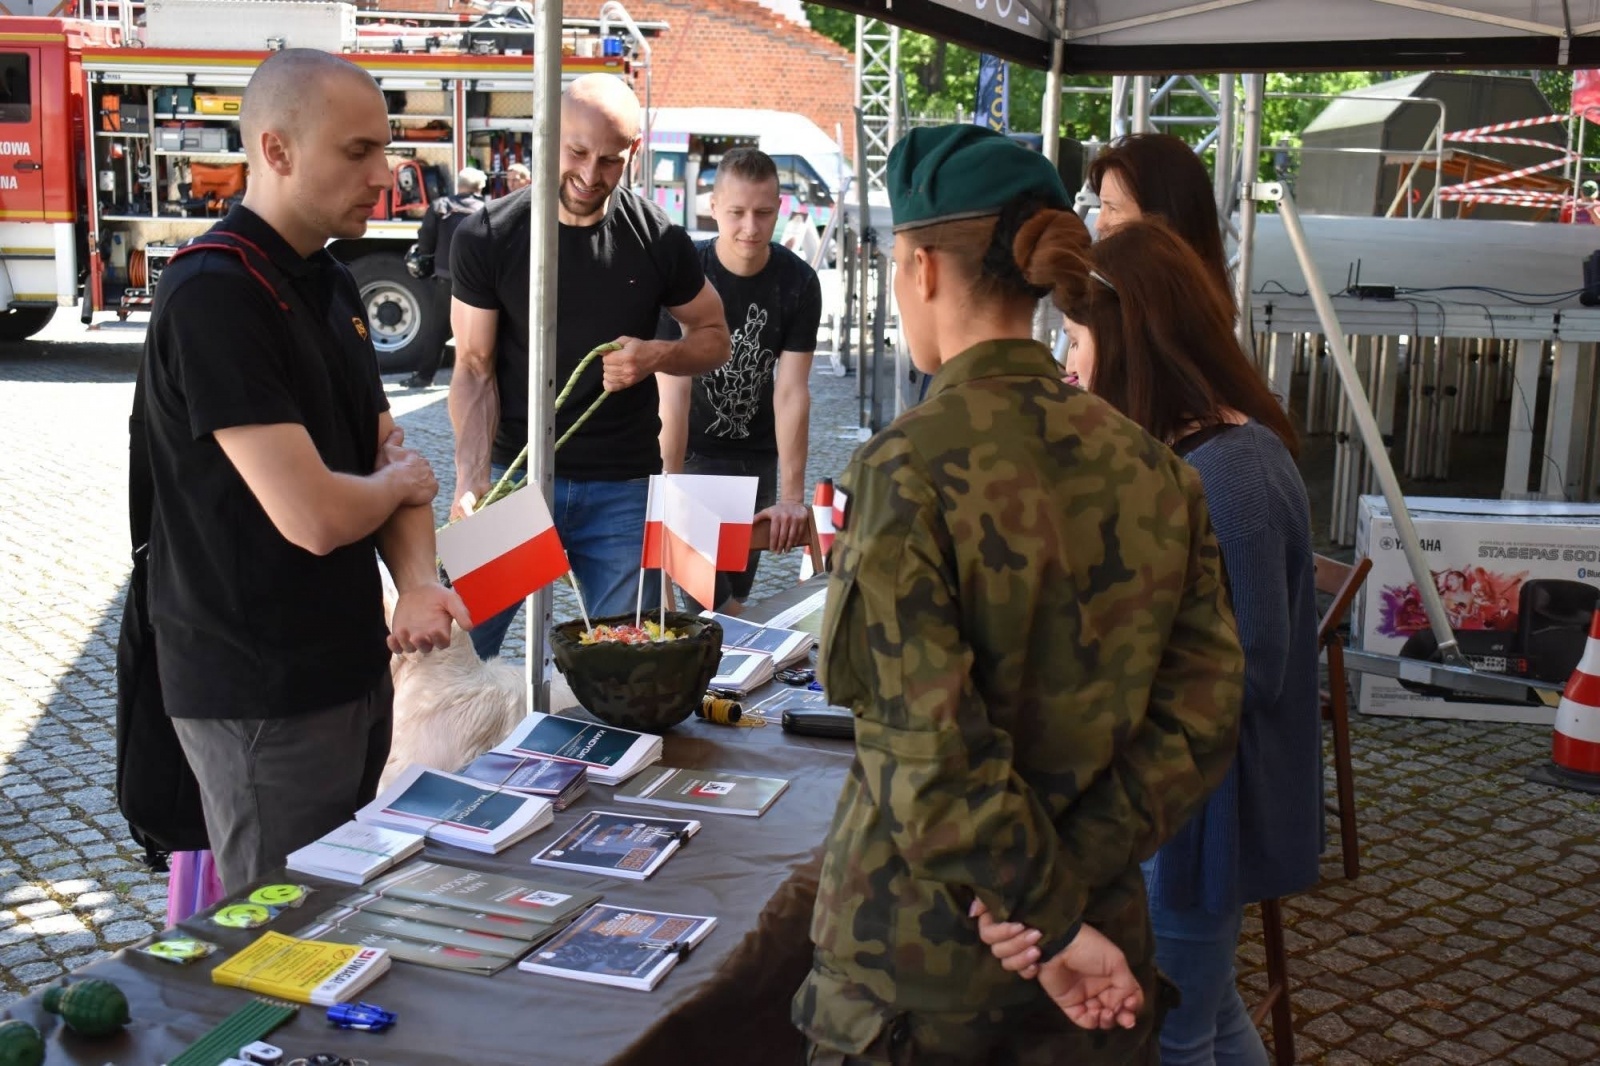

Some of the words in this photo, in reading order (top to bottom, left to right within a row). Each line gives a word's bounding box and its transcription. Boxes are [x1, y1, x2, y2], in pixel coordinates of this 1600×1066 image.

[1395, 538, 1442, 551] YAHA
[1478, 545, 1559, 561] STAGEPAS
[1562, 549, 1600, 562] 600
